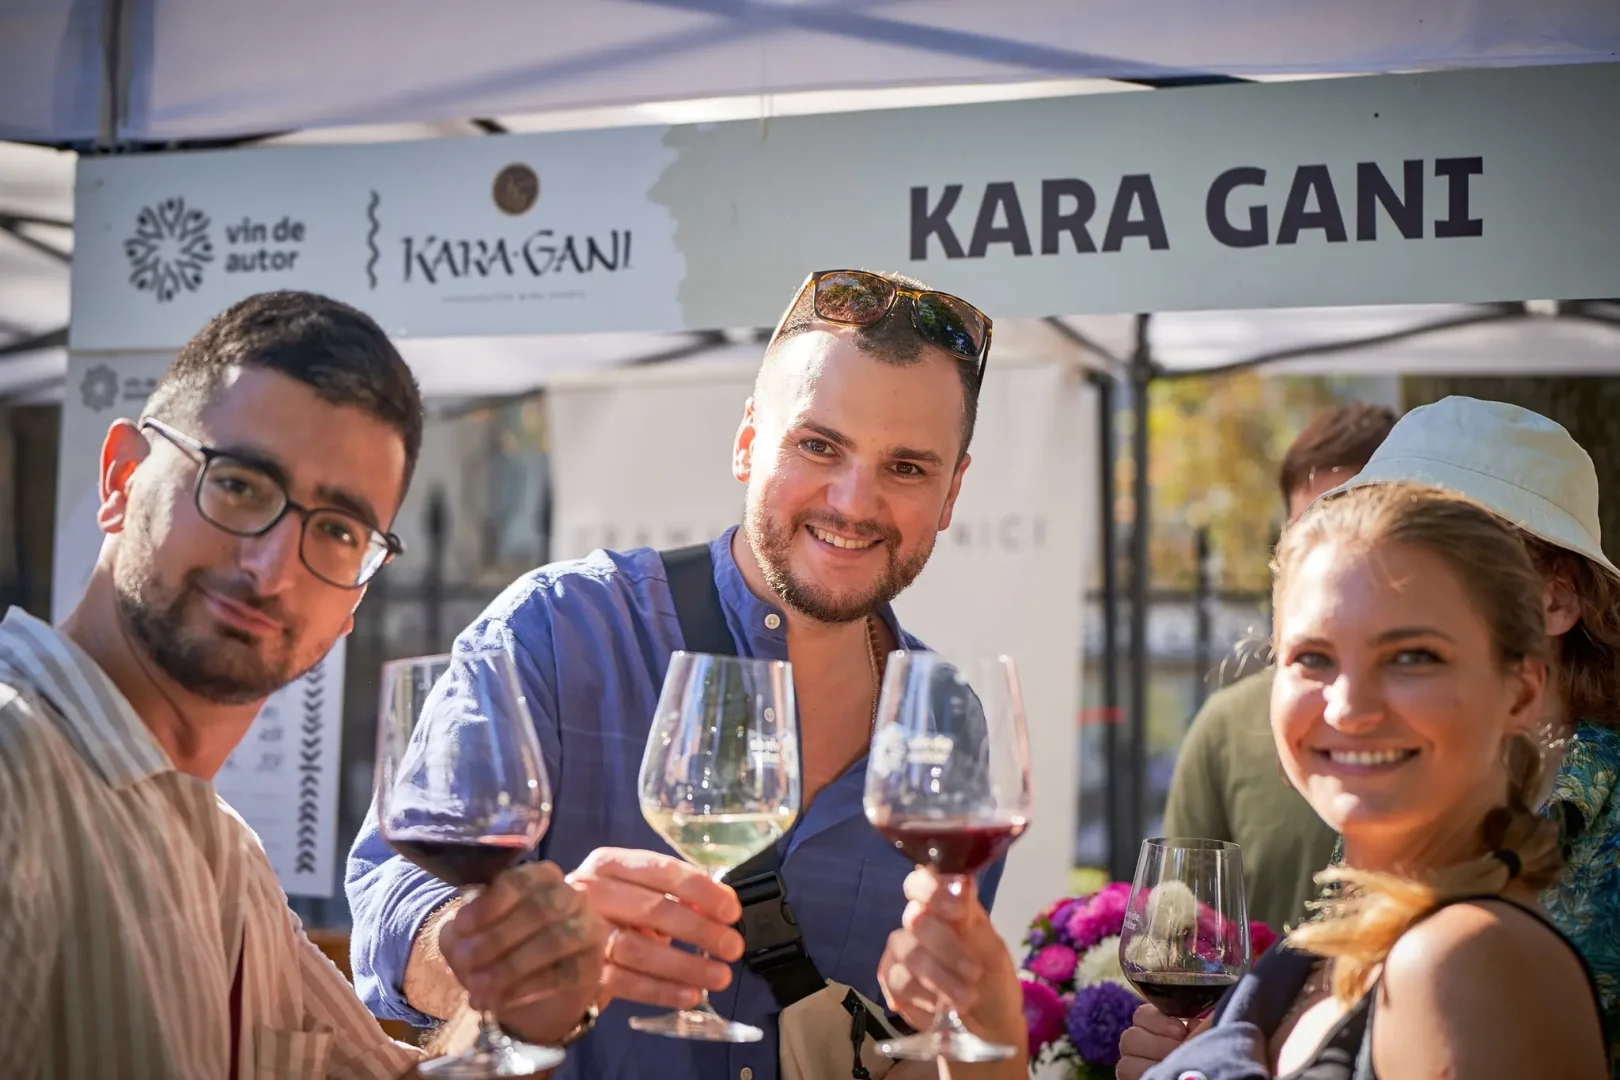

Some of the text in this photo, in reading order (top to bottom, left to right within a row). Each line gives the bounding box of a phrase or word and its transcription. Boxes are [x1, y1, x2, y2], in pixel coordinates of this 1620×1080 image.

[910, 156, 1484, 261] KARA GANI
[225, 216, 306, 245] vin de
[225, 249, 299, 273] autor
